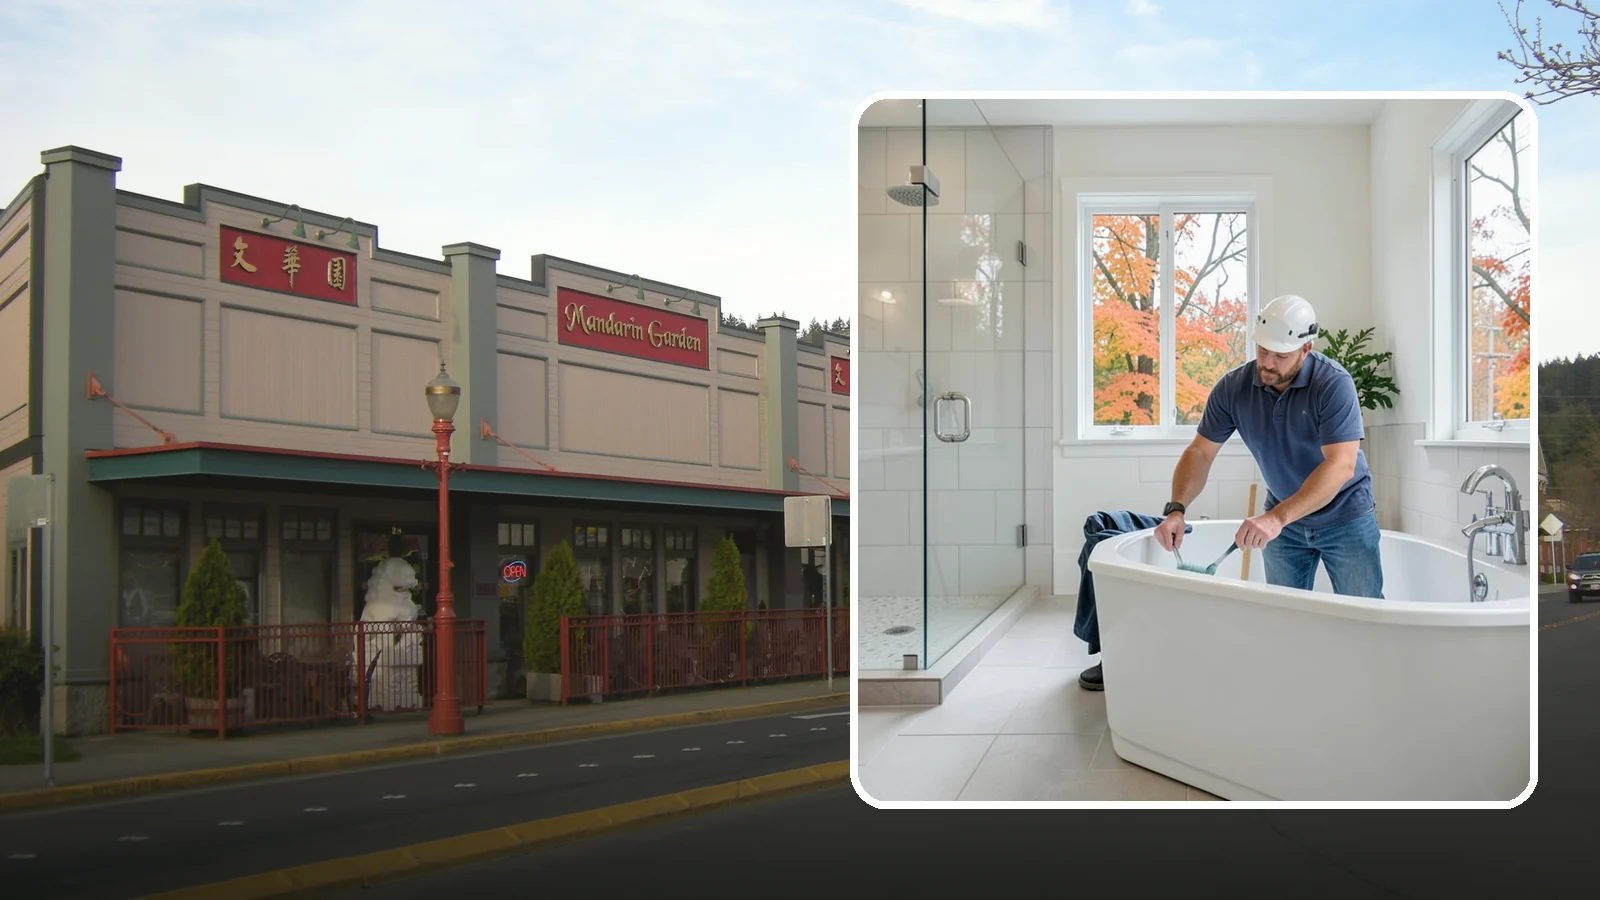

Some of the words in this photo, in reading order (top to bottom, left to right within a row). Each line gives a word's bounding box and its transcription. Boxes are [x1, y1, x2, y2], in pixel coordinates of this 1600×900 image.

[230, 235, 346, 291] 文華園
[564, 302, 644, 341] Mandarin
[648, 320, 701, 352] Garden
[503, 565, 527, 578] OPEN
